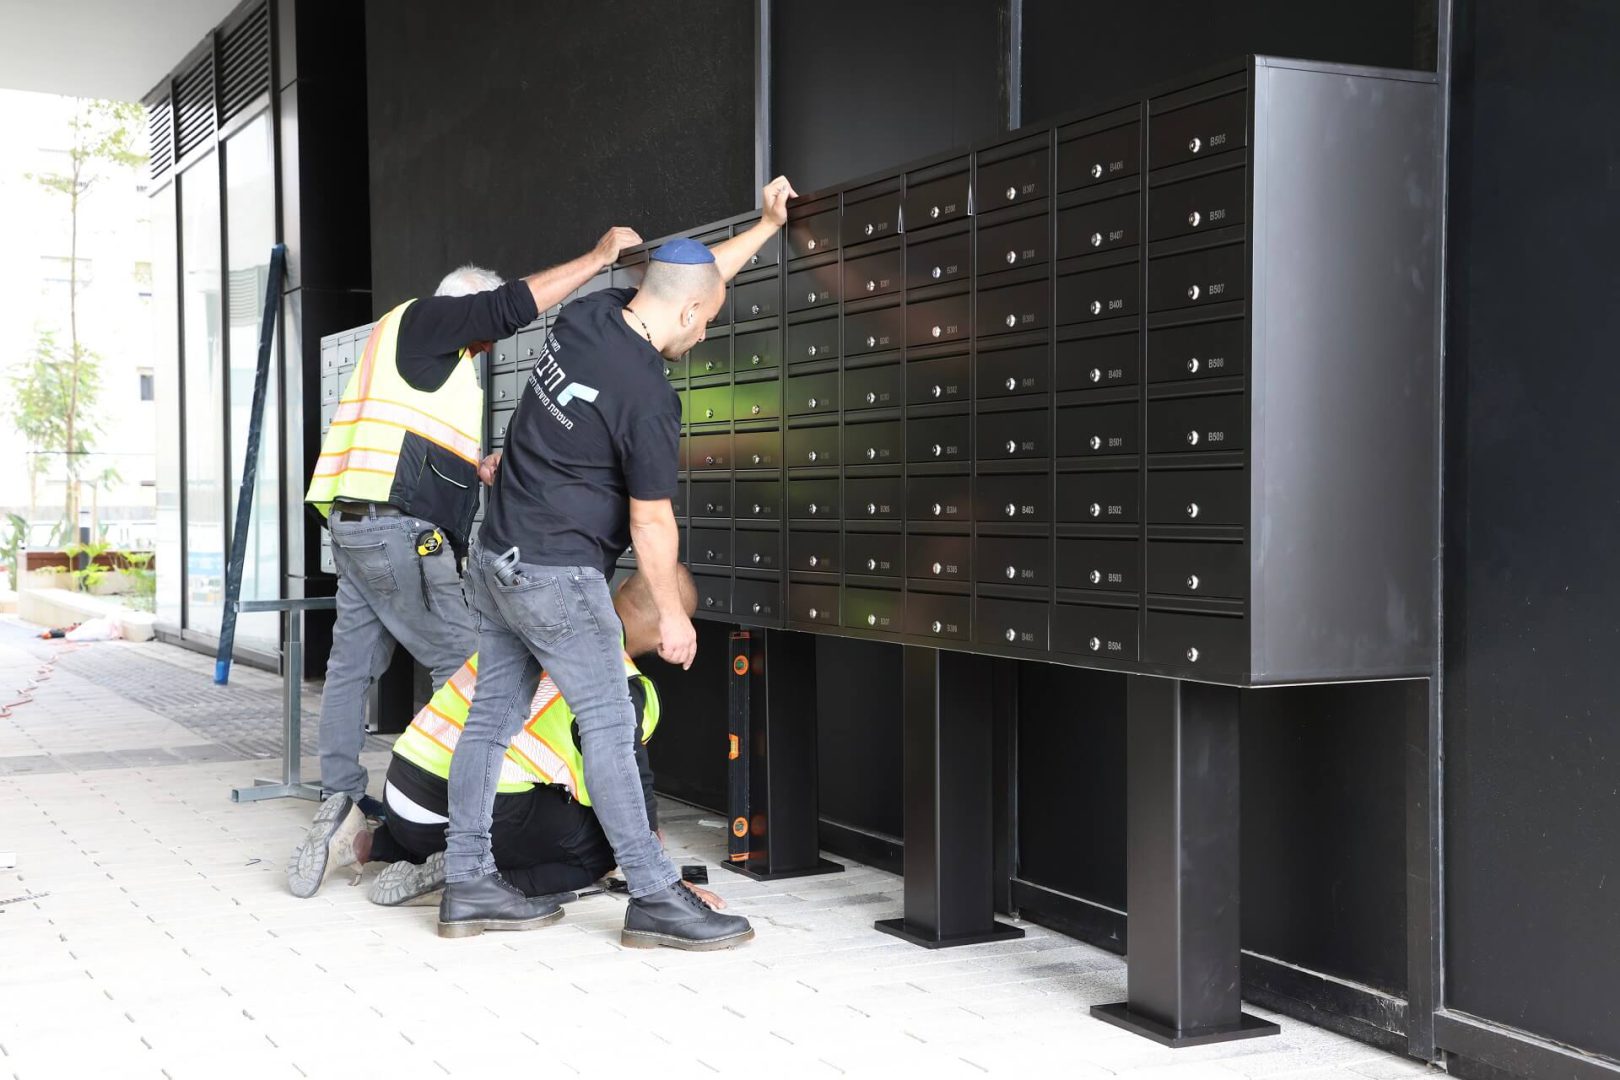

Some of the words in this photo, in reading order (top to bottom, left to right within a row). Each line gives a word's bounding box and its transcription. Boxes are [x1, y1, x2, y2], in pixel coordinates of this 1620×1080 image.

[1210, 133, 1226, 147] B505
[1209, 208, 1226, 222] B506
[1109, 229, 1124, 241] B407
[1209, 282, 1225, 296] B507
[1208, 356, 1225, 369] B508
[1108, 368, 1123, 379] B409
[547, 403, 574, 430] מעטפת
[1108, 437, 1123, 447] B501
[1208, 430, 1225, 442] B509
[1108, 504, 1123, 514] B502
[1108, 572, 1123, 583] B503
[1108, 639, 1123, 652] B504
